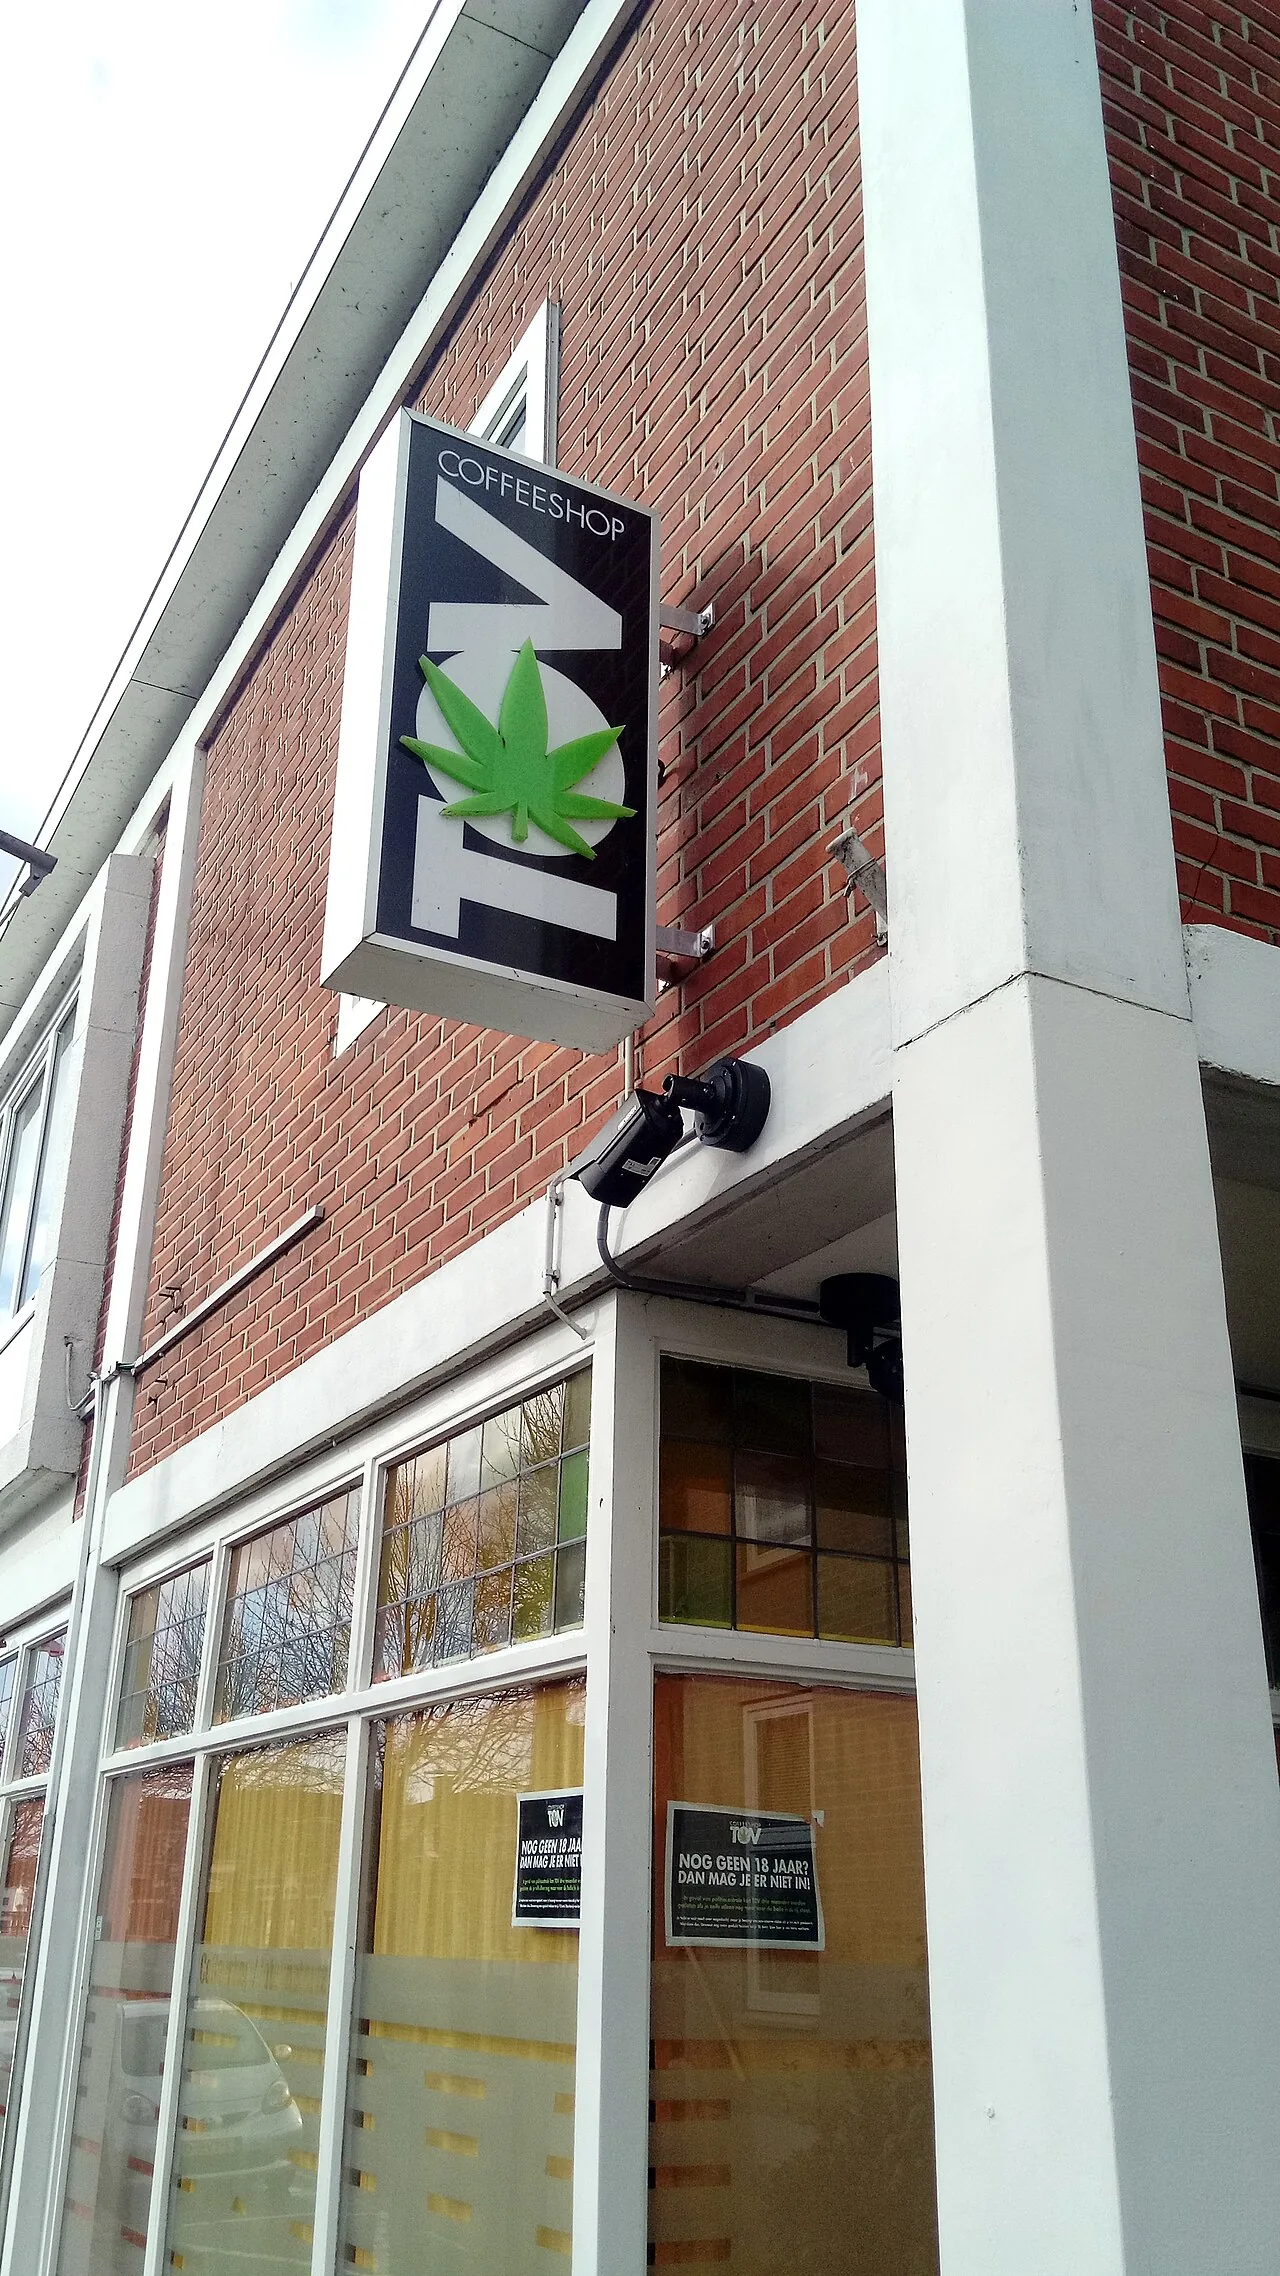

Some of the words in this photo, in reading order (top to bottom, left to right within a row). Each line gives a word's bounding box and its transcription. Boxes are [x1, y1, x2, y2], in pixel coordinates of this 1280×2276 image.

[436, 448, 626, 541] COFFEESHOP
[410, 474, 626, 942] TOV
[547, 1809, 565, 1827] TOV
[730, 1826, 762, 1845] TOV
[521, 1840, 538, 1855] NOG
[538, 1839, 558, 1854] GEEN
[559, 1838, 567, 1853] 18
[520, 1856, 533, 1869] DAN
[533, 1855, 548, 1868] MAG
[549, 1855, 556, 1868] JE
[556, 1854, 564, 1868] ER
[564, 1854, 579, 1868] NIET
[679, 1853, 712, 1870] NOG
[716, 1855, 750, 1872] GEEN
[755, 1857, 769, 1873] 18
[773, 1858, 809, 1875] JAAR?
[678, 1870, 705, 1885] DAN
[708, 1872, 736, 1887] MAG
[739, 1873, 751, 1887] JE
[754, 1874, 767, 1888] ER
[770, 1875, 792, 1889] NIET
[795, 1876, 811, 1890] IN!
